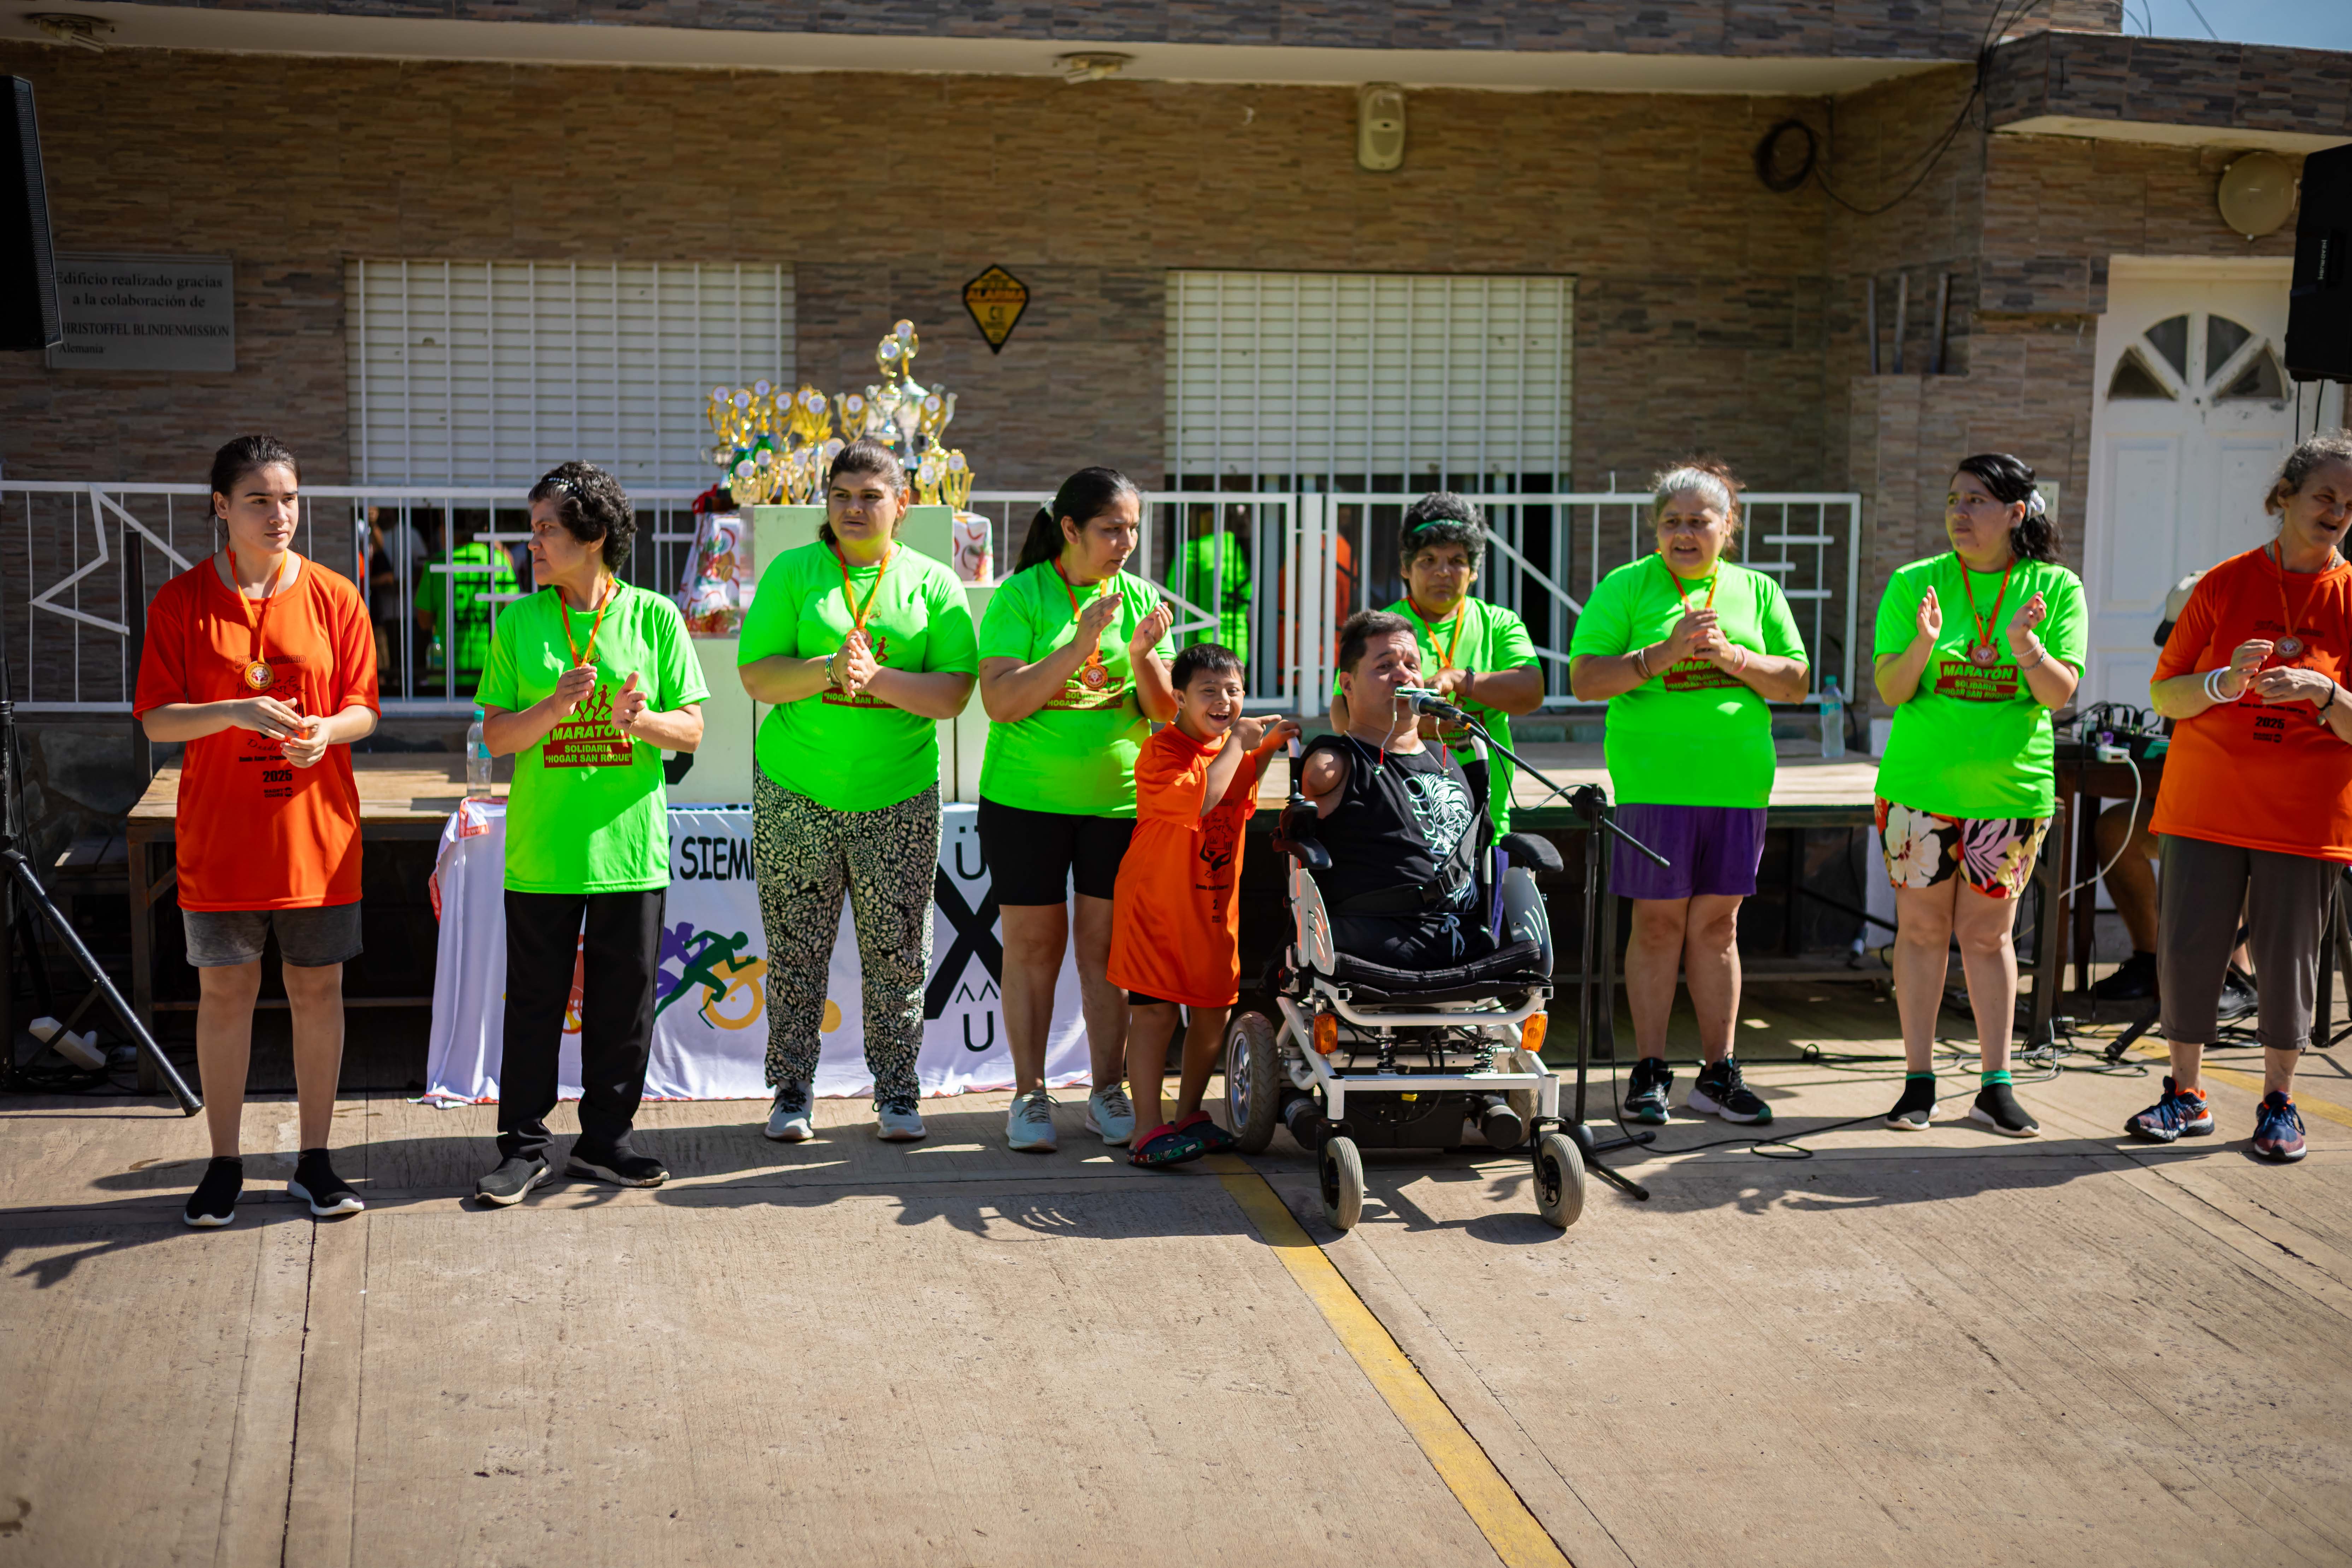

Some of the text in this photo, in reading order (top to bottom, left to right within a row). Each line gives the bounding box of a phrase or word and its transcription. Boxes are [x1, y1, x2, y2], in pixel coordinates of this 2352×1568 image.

[56, 272, 223, 291] Edificio realizado gracias
[72, 293, 205, 308] a la colaboración de
[62, 322, 229, 337] HRISTOFFEL BLINDENMISSION
[1672, 661, 1713, 673] MARA
[1944, 664, 2014, 680] MARATÓN
[1955, 679, 1997, 691] SOLIDARIA
[855, 695, 871, 704] SAN
[1966, 690, 1983, 698] SAN
[2256, 716, 2285, 729] 2025
[565, 744, 612, 753] SOLIDARIA
[580, 754, 598, 763] SAN
[263, 769, 293, 783] 2025
[1402, 776, 1447, 872] NCHO
[679, 836, 755, 881] SIEM
